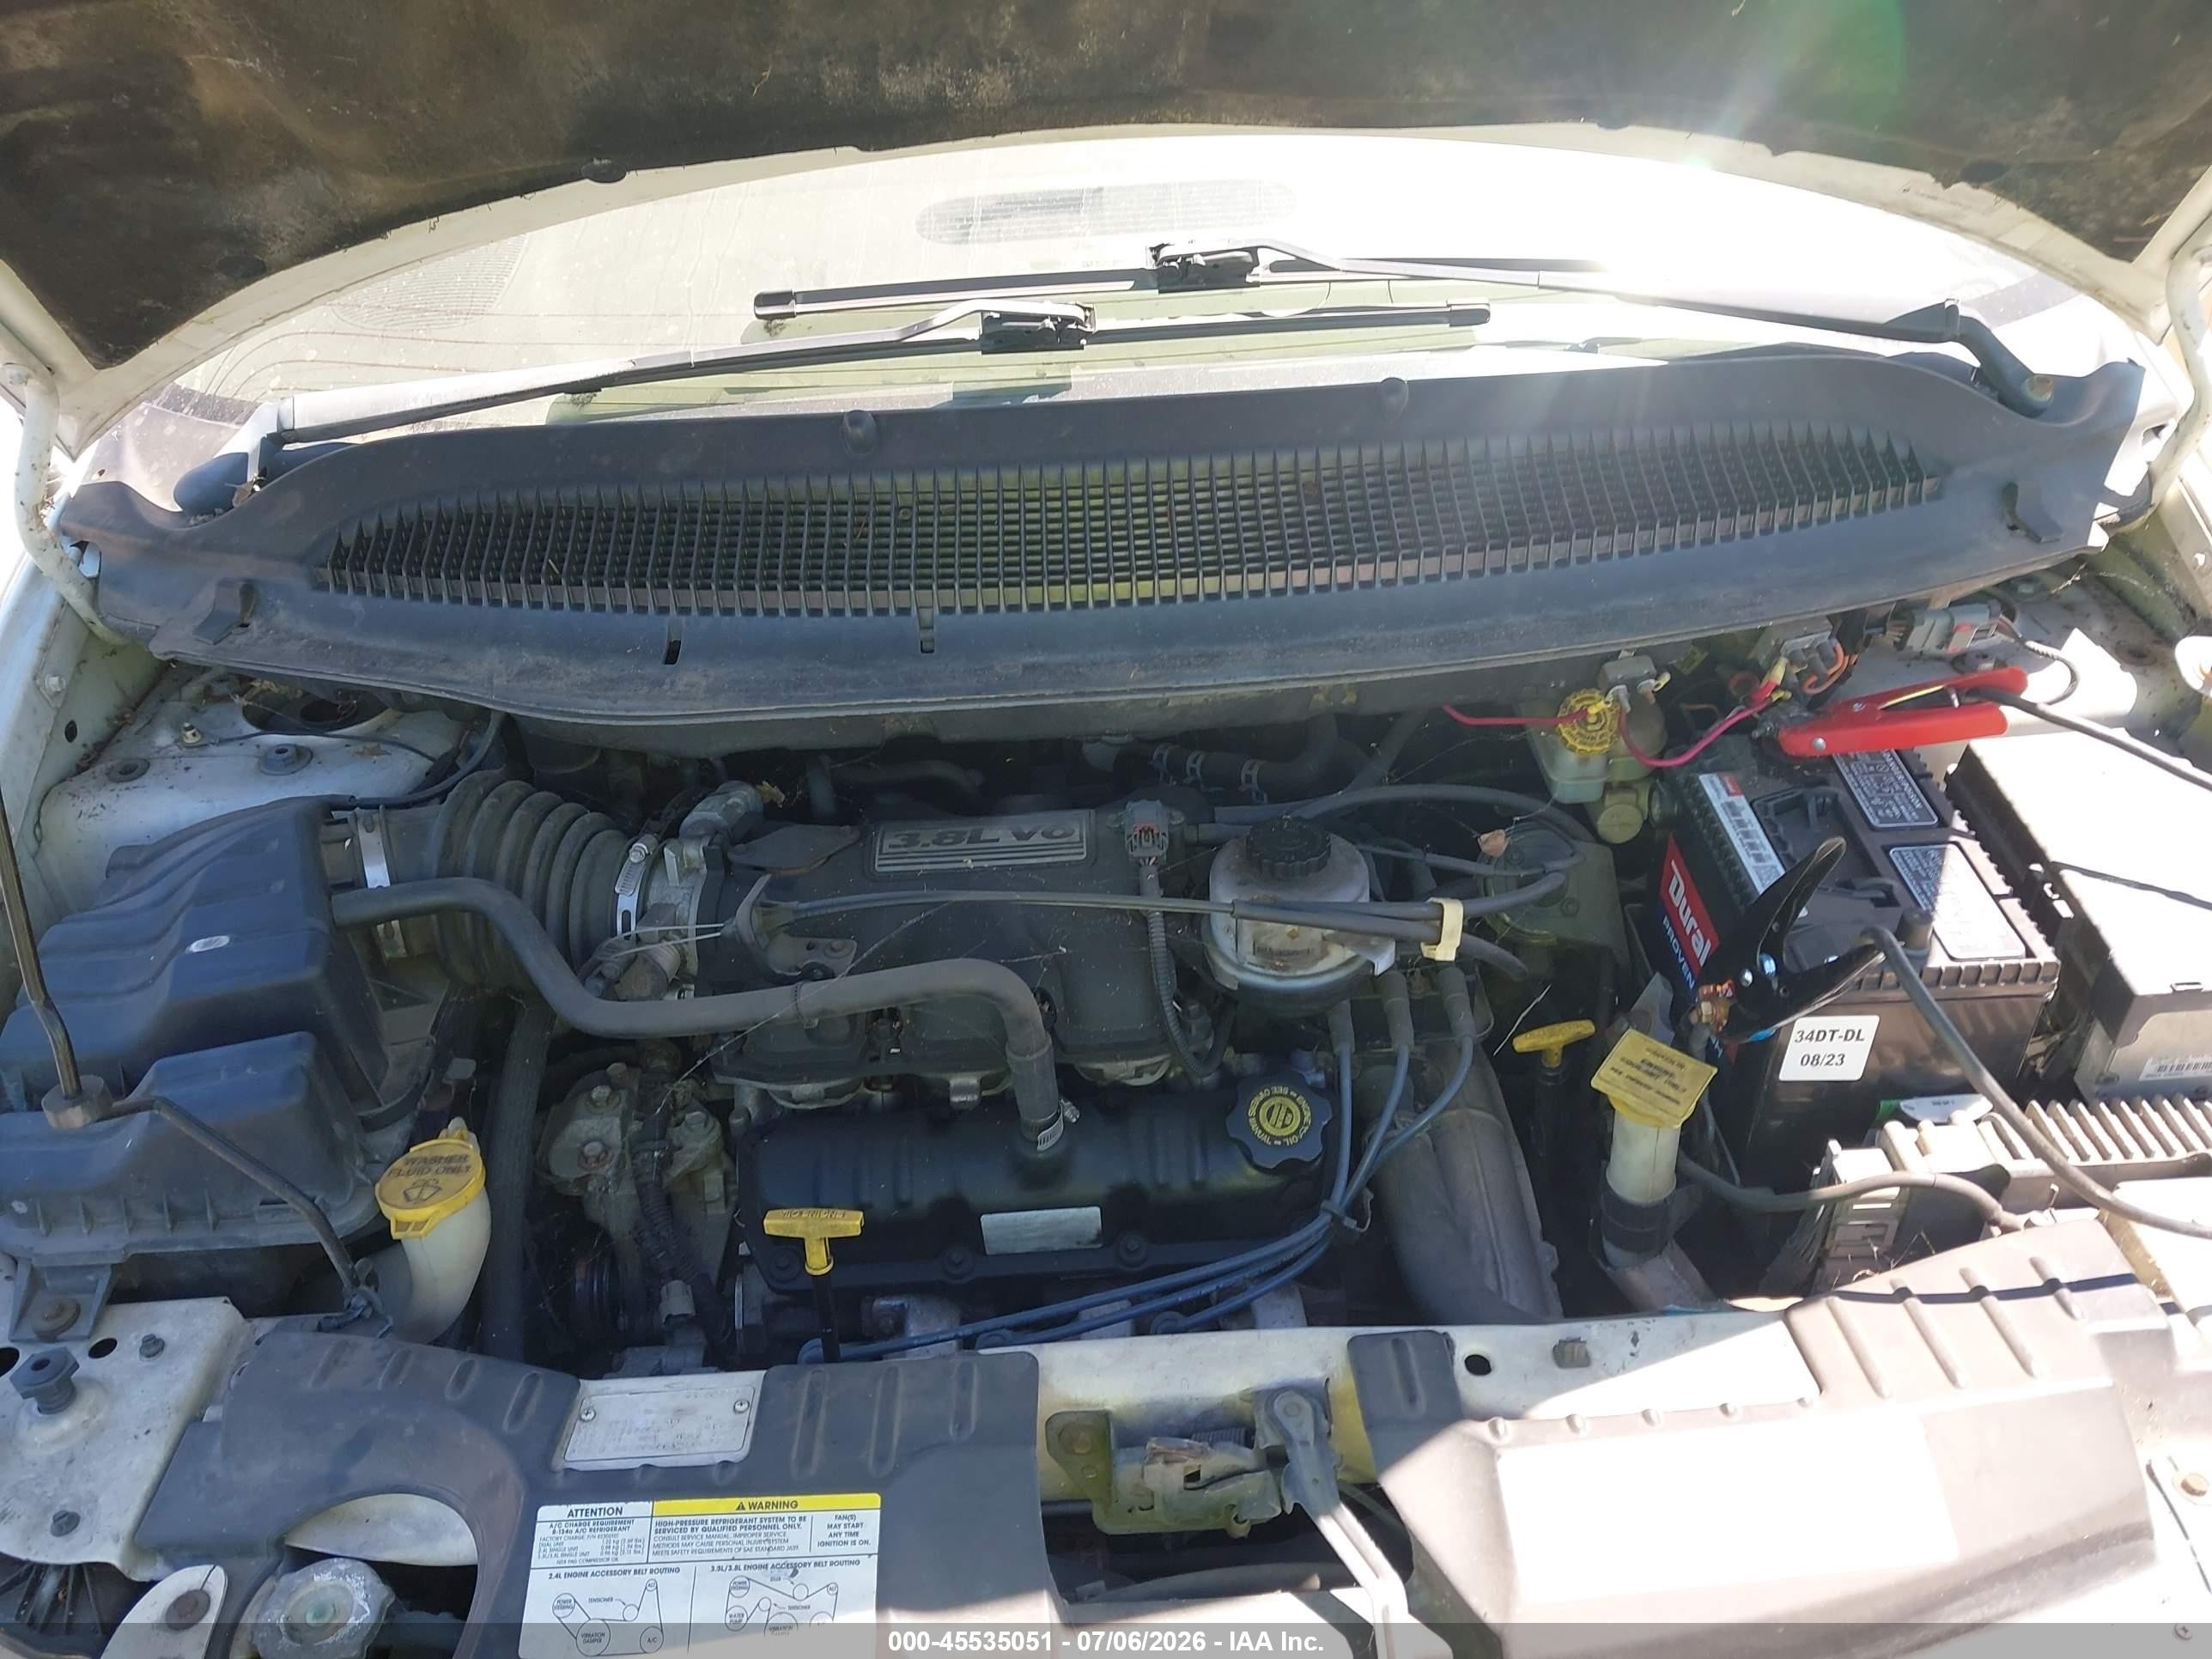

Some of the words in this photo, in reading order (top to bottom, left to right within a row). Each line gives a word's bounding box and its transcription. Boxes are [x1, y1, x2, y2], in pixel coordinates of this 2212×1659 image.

[888, 829, 1000, 848] 3.8L
[1668, 859, 1712, 968] Dural
[1662, 915, 1696, 989] PROVEN
[1795, 1029, 1865, 1042] 34DT-DL
[1800, 1051, 1845, 1066] 08/23
[1284, 1134, 1298, 1146] OIL
[405, 1153, 470, 1166] WASHER
[387, 1167, 431, 1177] FLUID
[435, 1165, 472, 1176] ONLY
[748, 1500, 799, 1510] WARNING
[567, 1506, 623, 1518] ATTENTION
[711, 1564, 742, 1572] 3.3L/3.8L
[769, 1561, 812, 1570] ACCESSORY
